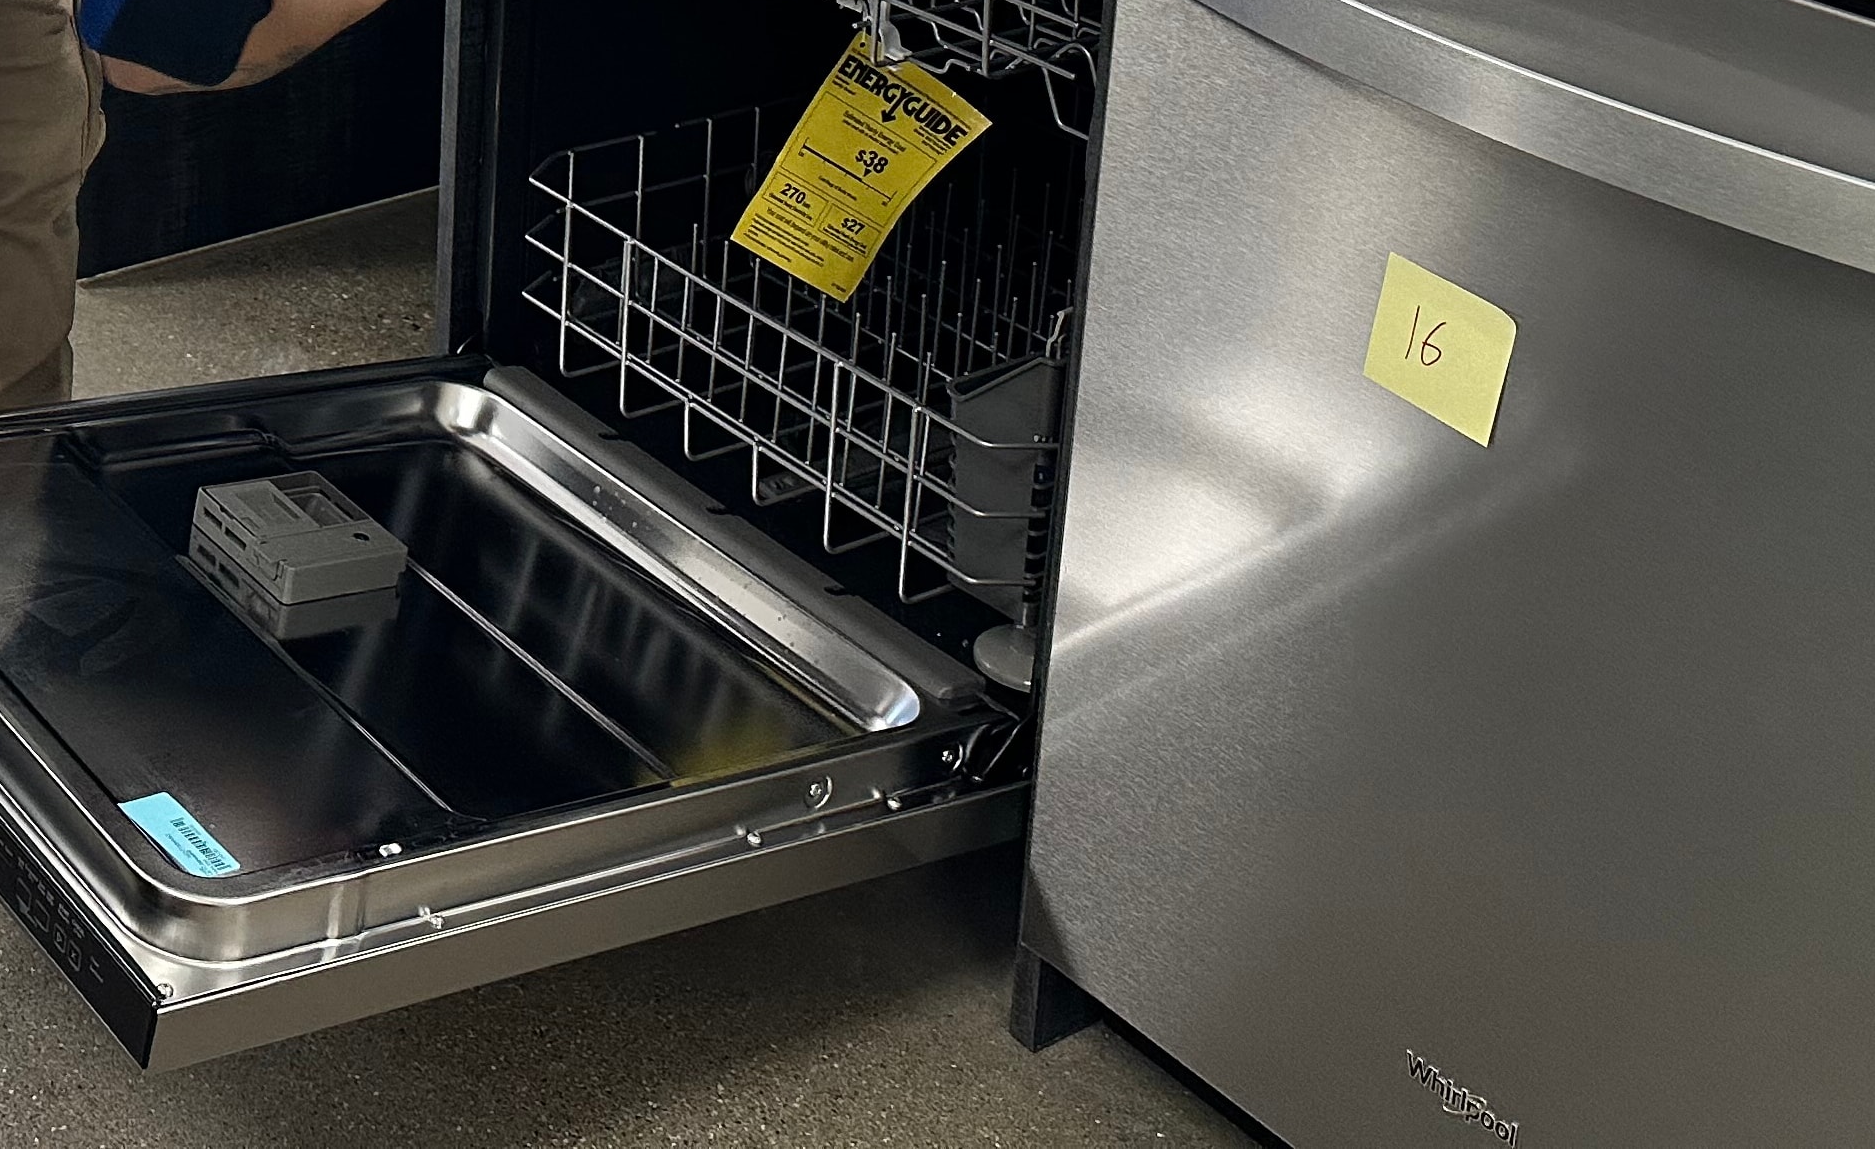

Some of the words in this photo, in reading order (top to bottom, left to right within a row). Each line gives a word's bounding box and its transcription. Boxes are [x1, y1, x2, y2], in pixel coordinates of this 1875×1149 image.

[837, 54, 969, 147] ENERGYGUIDE
[855, 149, 889, 174] $38
[841, 217, 866, 236] $27
[1404, 304, 1447, 367] 16
[1406, 1048, 1520, 1149] Whirlpool
